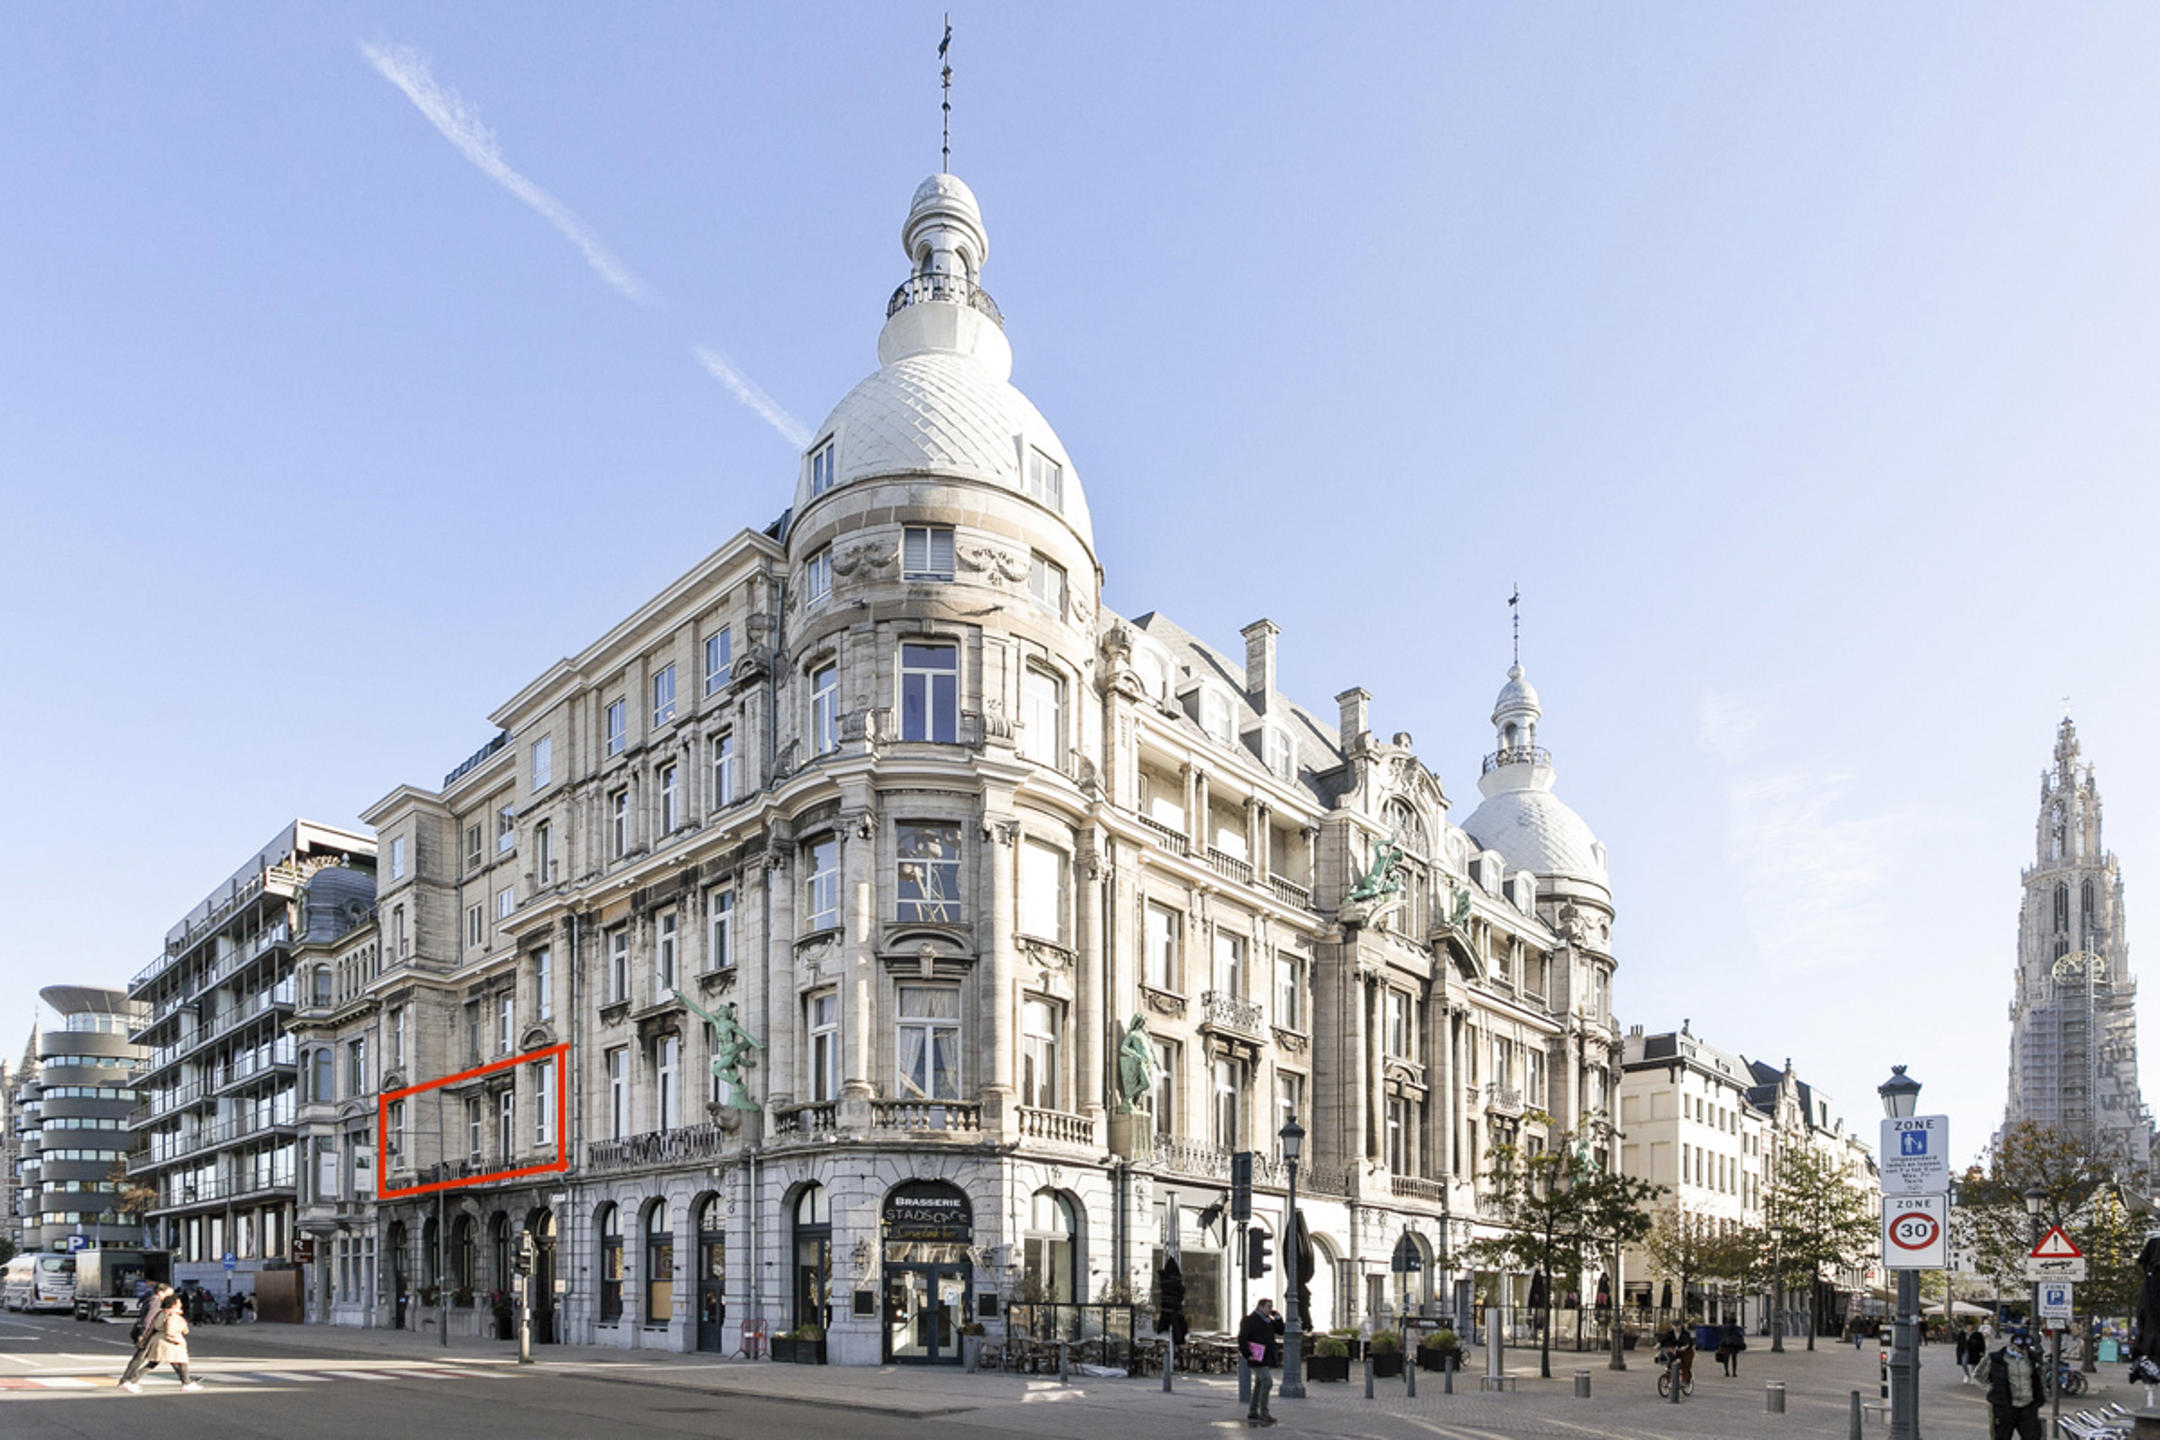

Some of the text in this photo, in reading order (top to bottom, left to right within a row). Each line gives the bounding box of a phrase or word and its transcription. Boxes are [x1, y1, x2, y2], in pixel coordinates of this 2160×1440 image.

[1895, 1120, 1934, 1131] ZONE
[1897, 1199, 1932, 1208] ZONE
[1901, 1223, 1927, 1238] 30
[68, 1236, 83, 1251] P
[2051, 1291, 2061, 1303] P
